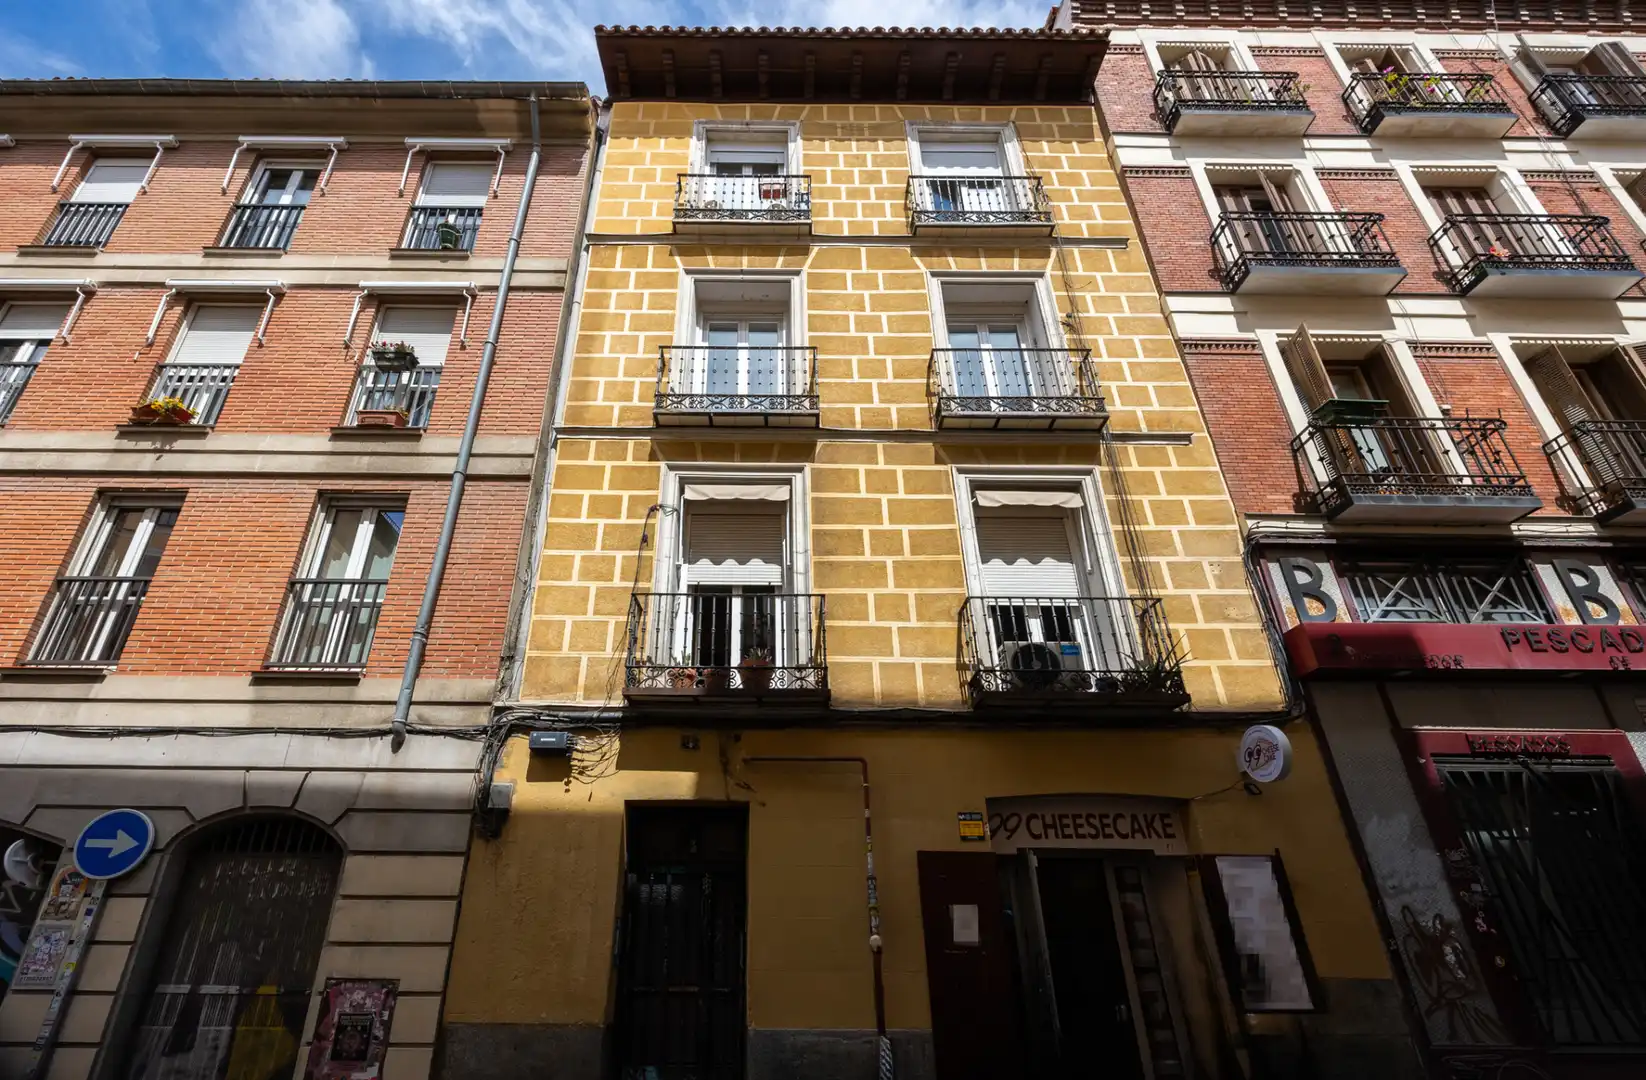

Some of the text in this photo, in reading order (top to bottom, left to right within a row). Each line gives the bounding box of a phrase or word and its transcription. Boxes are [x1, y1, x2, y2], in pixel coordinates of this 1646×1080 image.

[1277, 557, 1620, 625] B B
[1500, 627, 1645, 653] PESCAD
[1244, 744, 1261, 769] 99
[990, 812, 1021, 840] 99
[1026, 812, 1177, 839] CHEESECAKE
